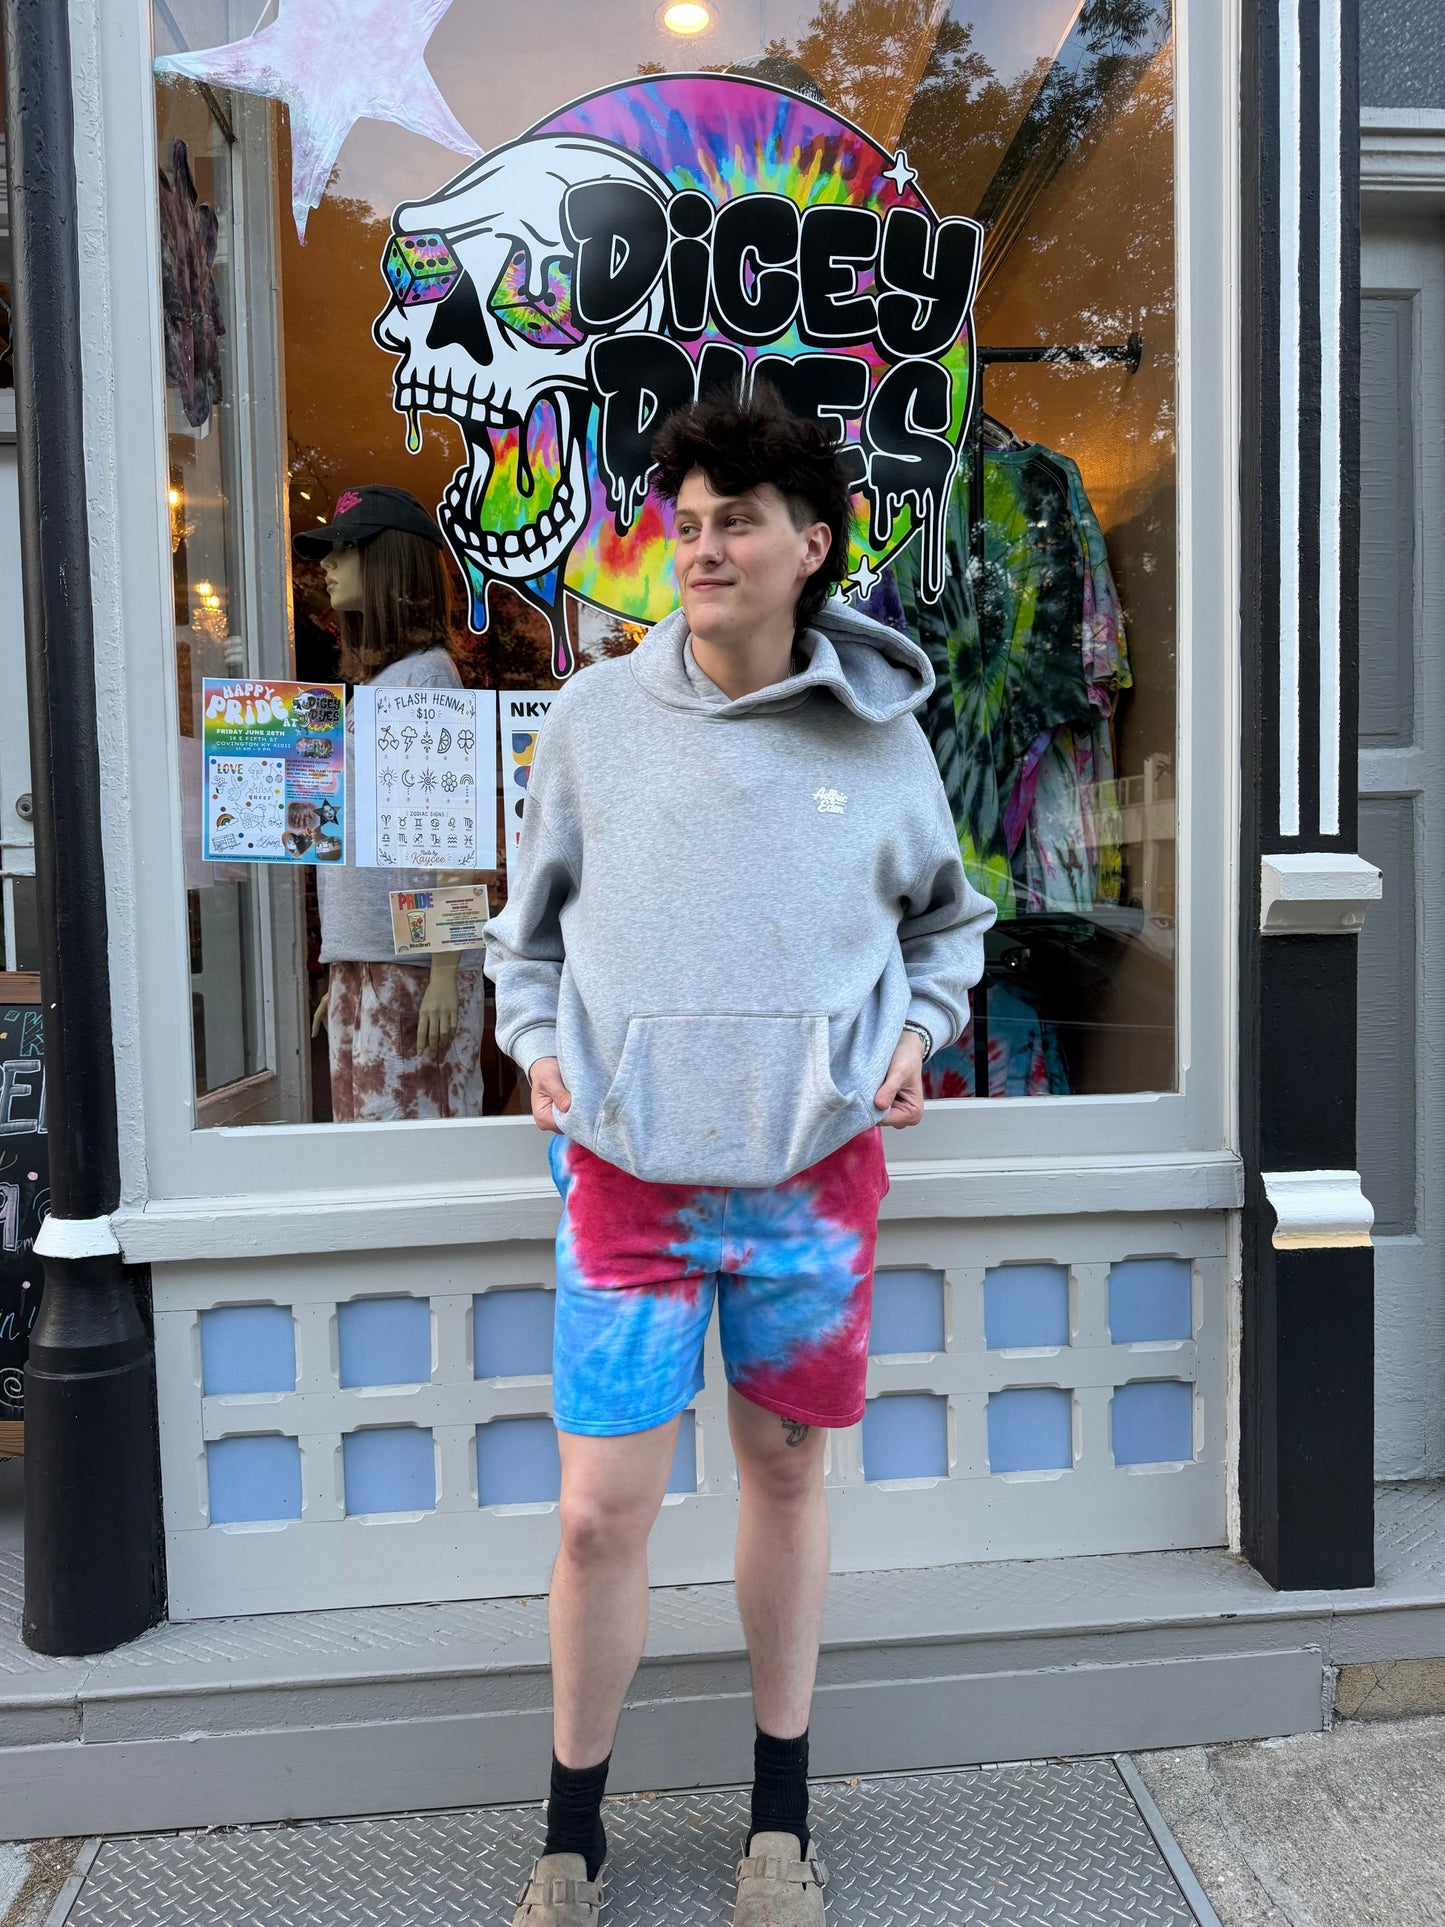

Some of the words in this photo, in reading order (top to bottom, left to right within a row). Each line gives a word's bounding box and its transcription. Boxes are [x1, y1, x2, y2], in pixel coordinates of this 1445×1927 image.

[223, 683, 275, 700] HAPPY
[394, 692, 427, 711] FLASH
[433, 692, 465, 716] HENNA
[310, 709, 340, 722] DYES
[416, 708, 436, 720] $10
[283, 718, 298, 728] AT
[216, 763, 244, 775] LOVE
[411, 852, 446, 866] Kaycee
[397, 892, 434, 911] PRIDE
